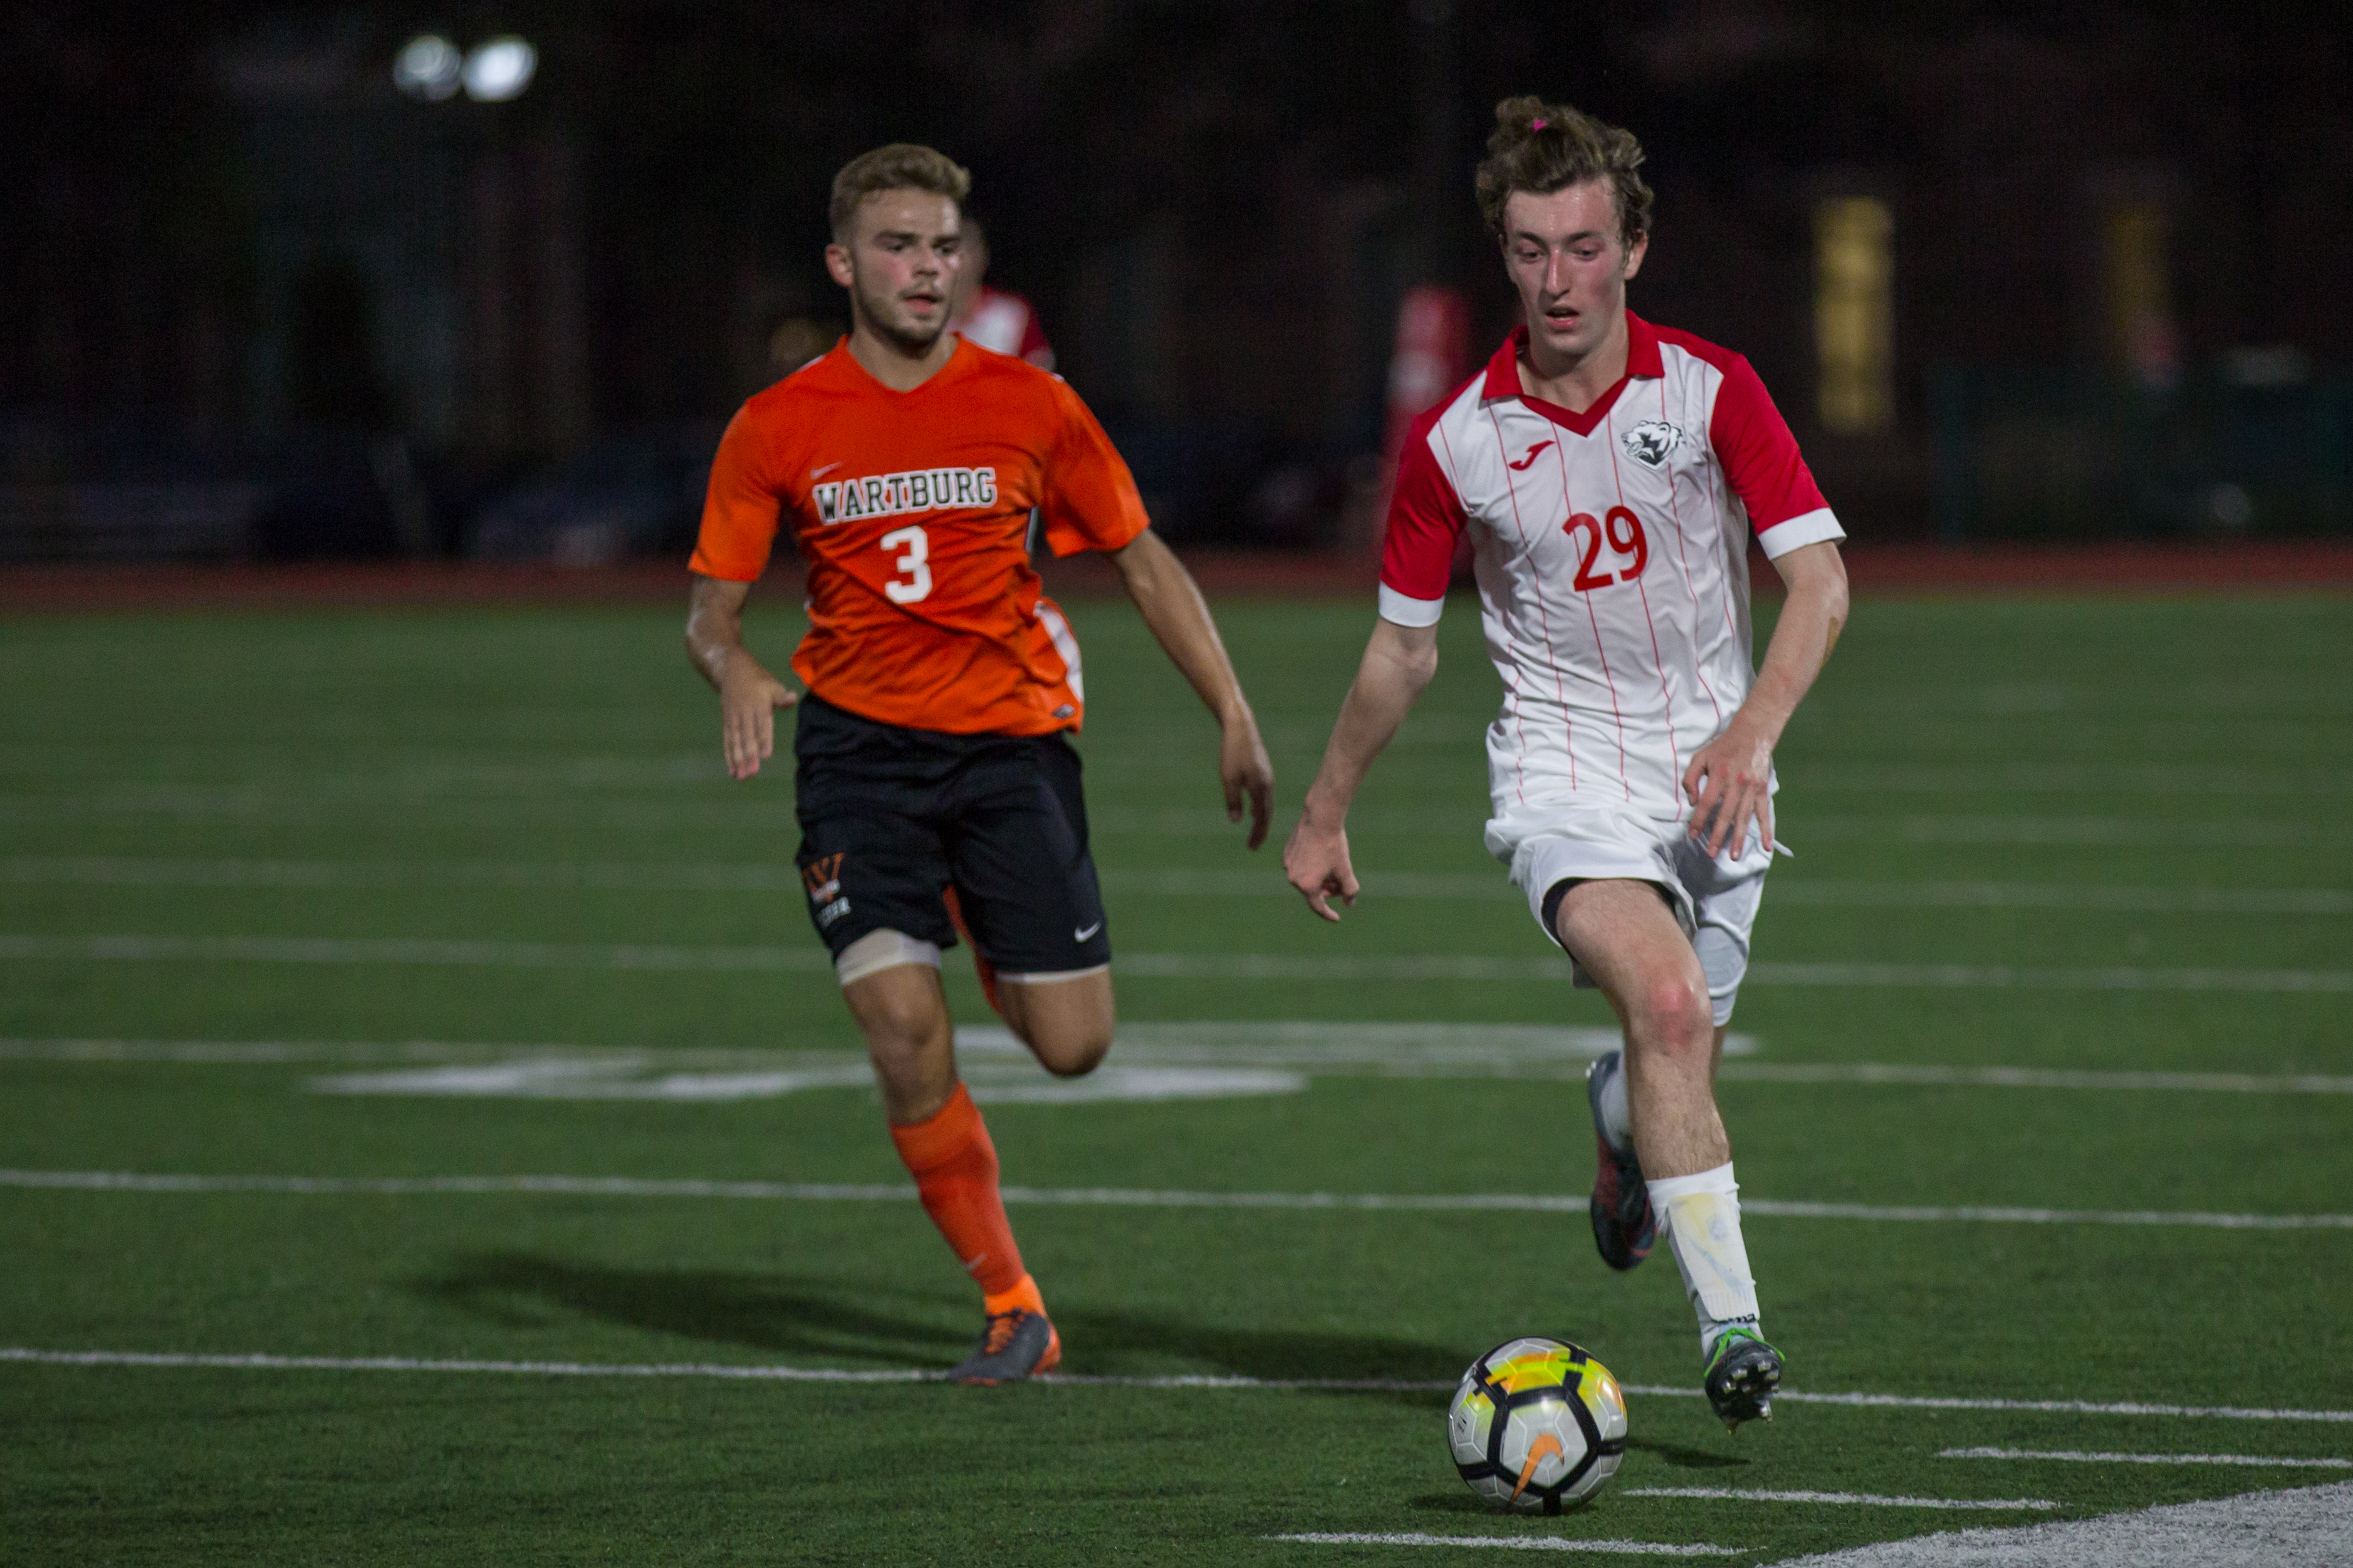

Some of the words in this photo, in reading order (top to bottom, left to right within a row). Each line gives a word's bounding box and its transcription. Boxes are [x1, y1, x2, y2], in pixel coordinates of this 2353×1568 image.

[812, 467, 998, 524] WARTBURG
[880, 525, 933, 604] 3
[1562, 506, 1648, 592] 29
